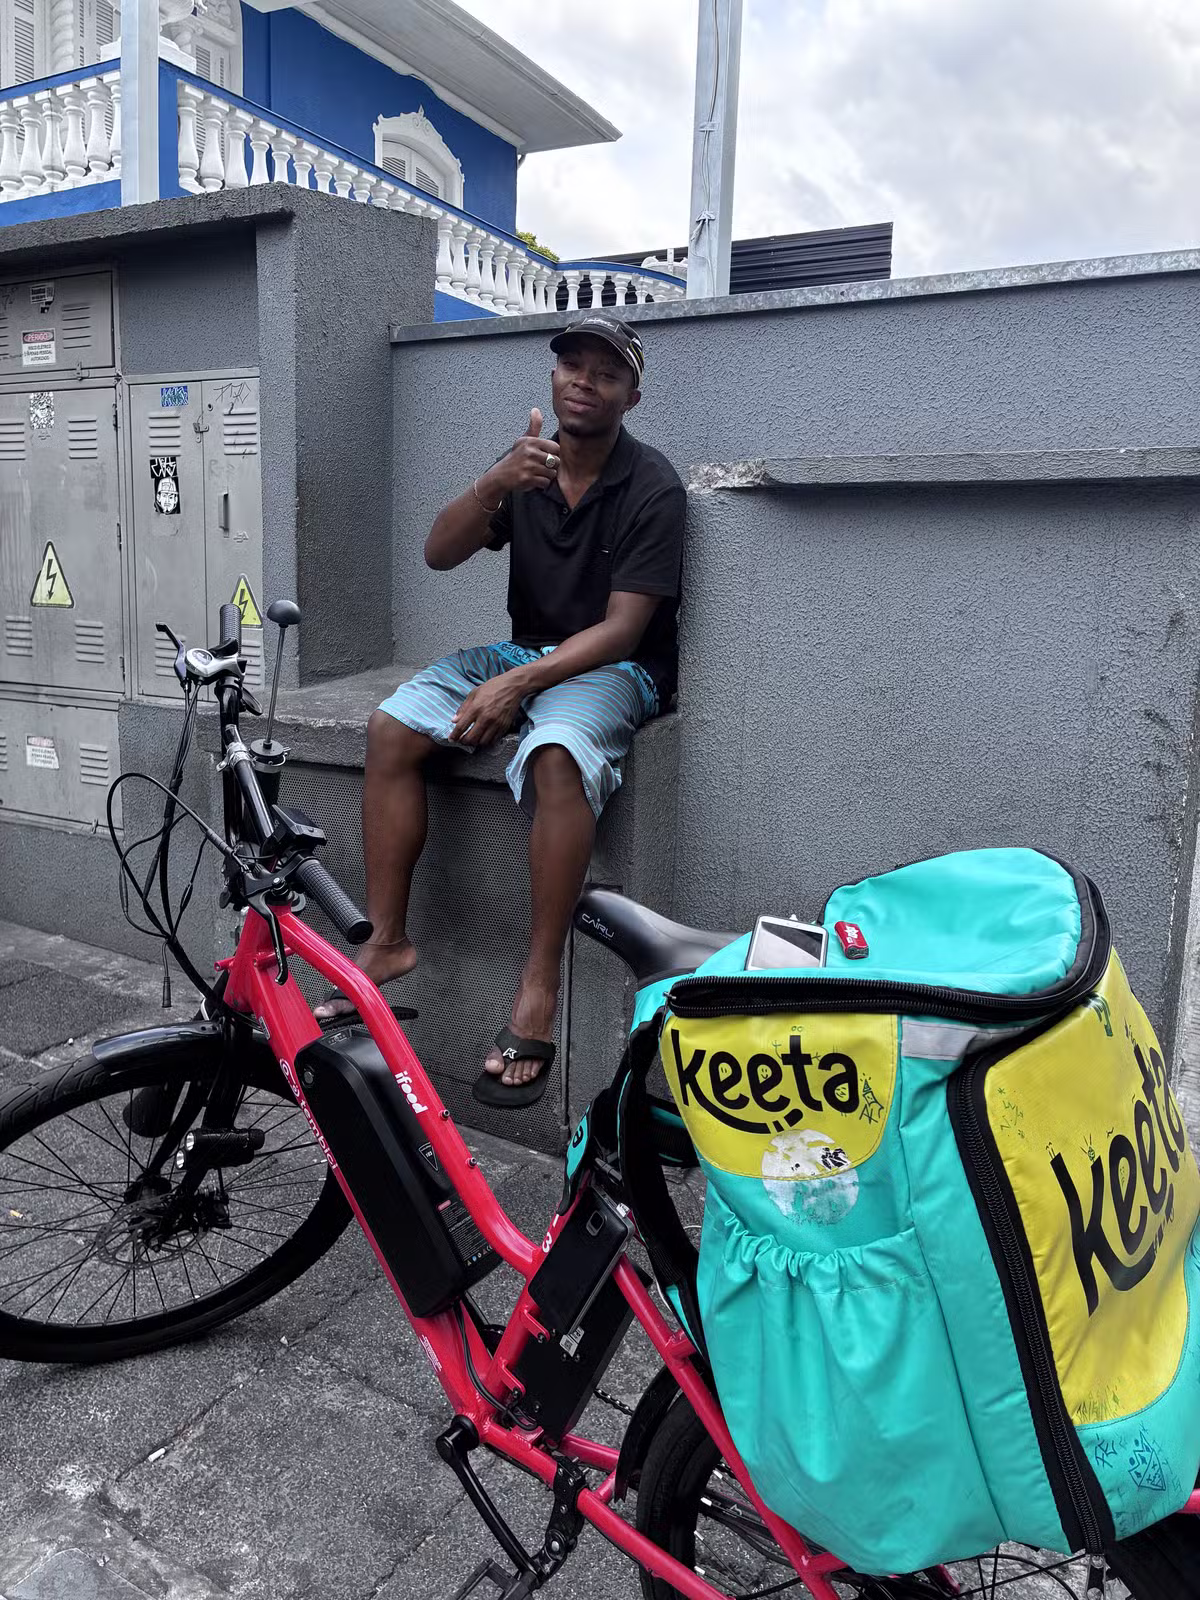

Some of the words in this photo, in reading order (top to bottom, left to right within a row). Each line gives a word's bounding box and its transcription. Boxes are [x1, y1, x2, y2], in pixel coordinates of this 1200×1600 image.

[28, 332, 49, 342] PERIGO
[394, 1070, 428, 1114] ifood
[671, 1028, 859, 1134] keeta
[300, 1099, 338, 1169] tembici
